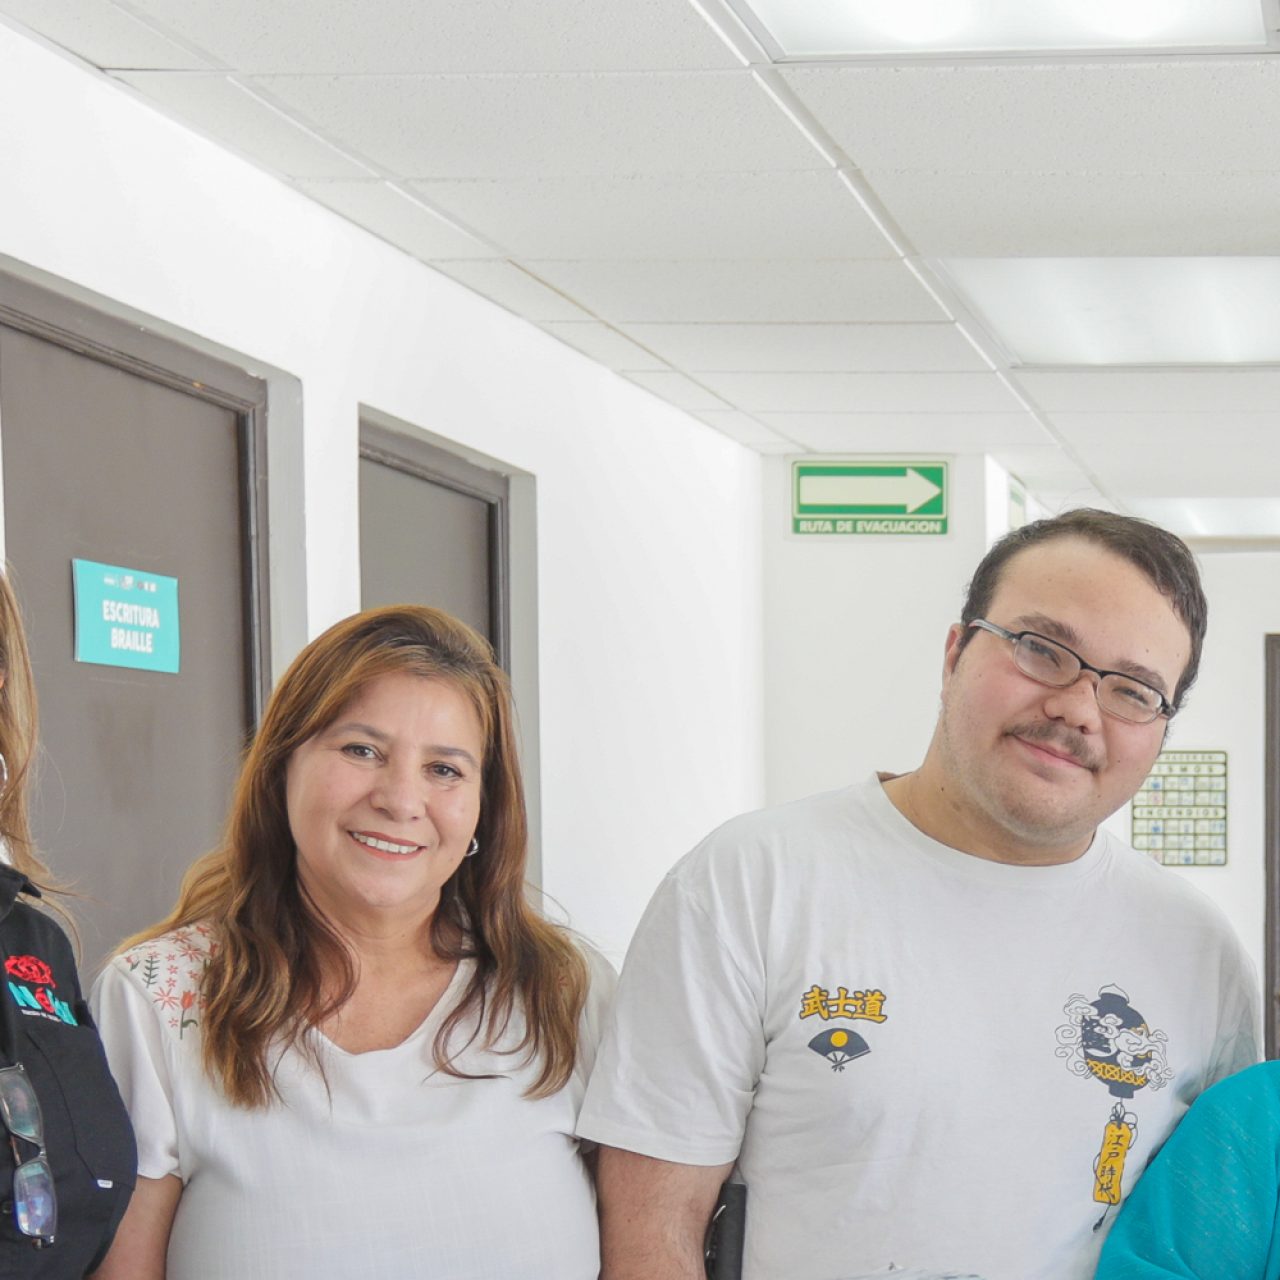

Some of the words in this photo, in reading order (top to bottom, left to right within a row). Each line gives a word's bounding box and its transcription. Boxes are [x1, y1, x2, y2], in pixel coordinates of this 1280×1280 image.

[799, 520, 833, 533] RUTA
[836, 520, 852, 533] DE
[856, 520, 942, 533] EVACUACION
[102, 599, 160, 629] ESCRITURA
[111, 627, 153, 654] BRAILLE
[799, 984, 888, 1024] 武士道
